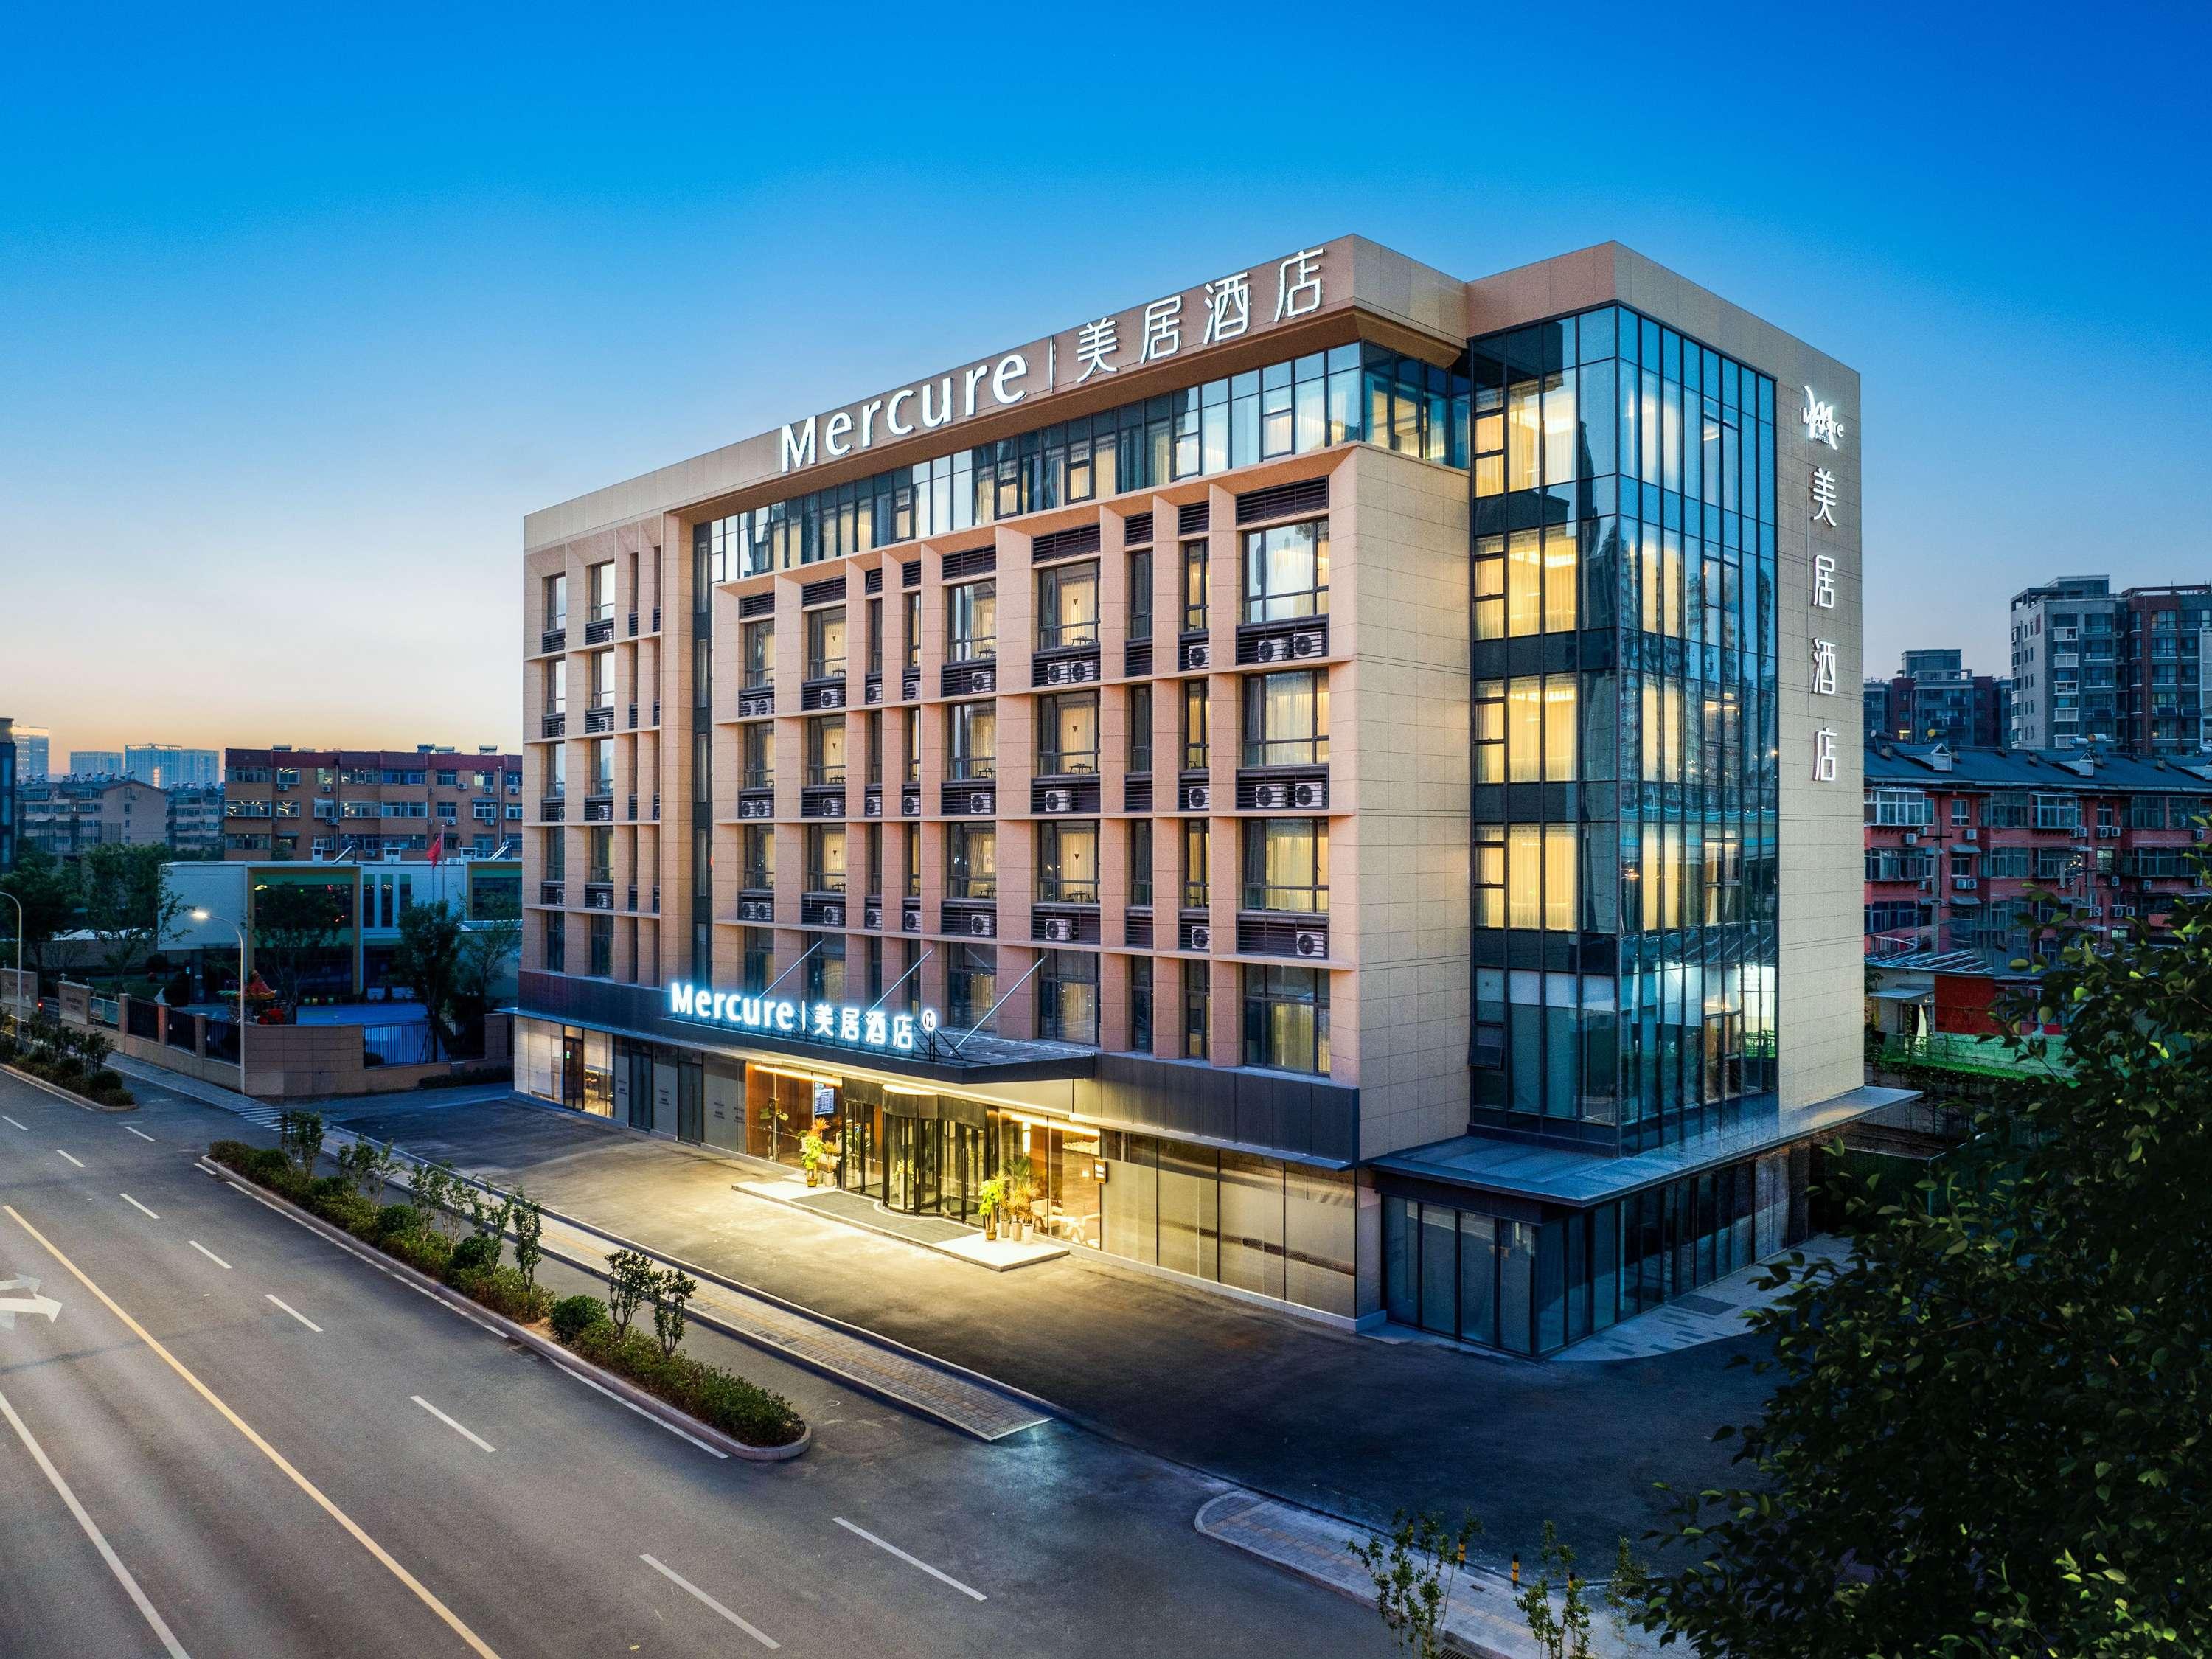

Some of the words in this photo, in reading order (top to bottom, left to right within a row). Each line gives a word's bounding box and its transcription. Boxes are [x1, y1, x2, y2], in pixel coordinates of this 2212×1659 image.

[780, 352, 1029, 473] Mercure
[1077, 247, 1326, 383] 美居酒店
[1801, 407, 1843, 438] Mere
[1812, 467, 1837, 782] 美居酒店
[672, 983, 795, 1030] Mercure
[814, 1004, 914, 1049] 美居酒店
